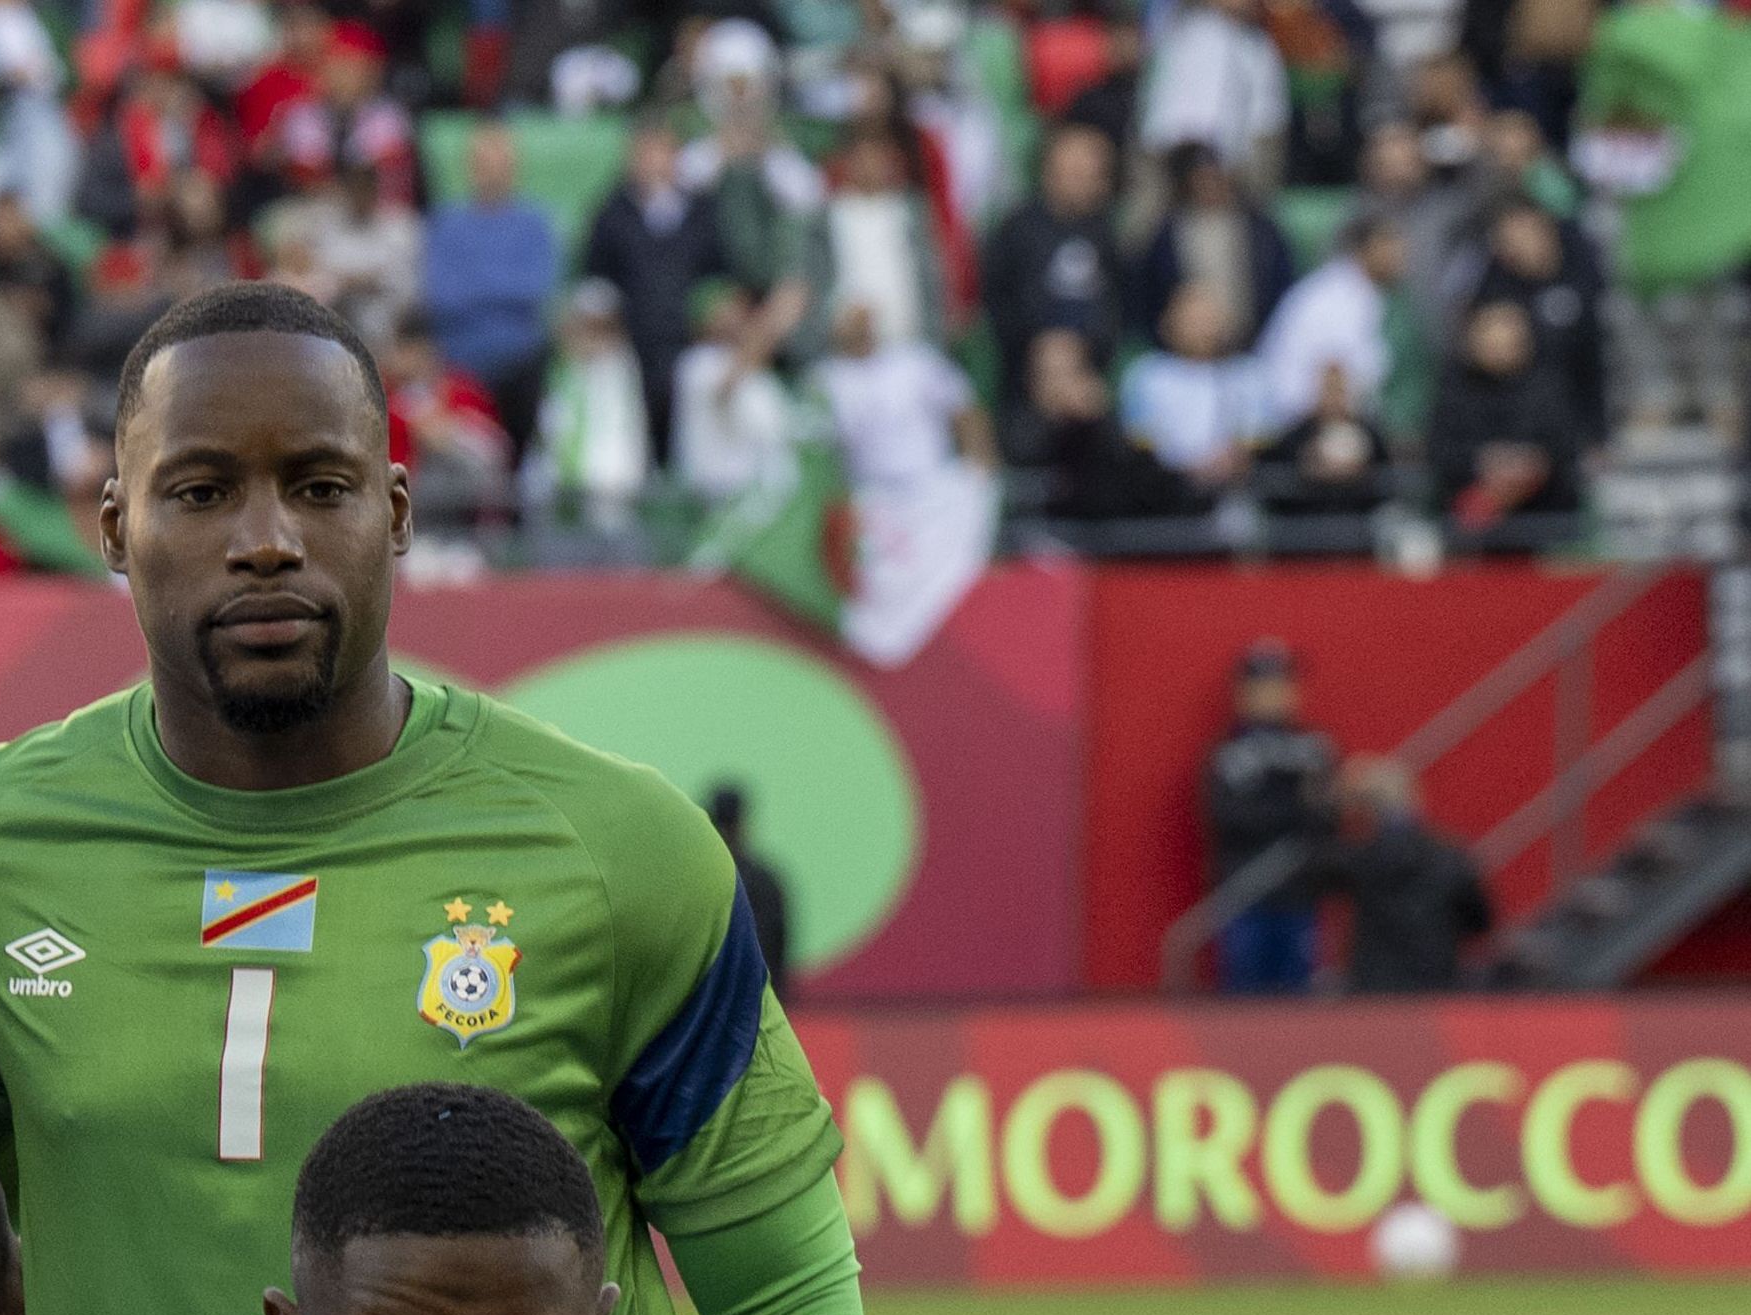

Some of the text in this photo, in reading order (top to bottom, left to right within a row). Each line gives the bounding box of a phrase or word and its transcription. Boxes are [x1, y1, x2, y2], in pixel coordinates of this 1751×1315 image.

[9, 975, 72, 997] umbro
[438, 1003, 499, 1027] FECOFA
[218, 966, 276, 1161] 1
[844, 1057, 1751, 1240] MOROCCO
